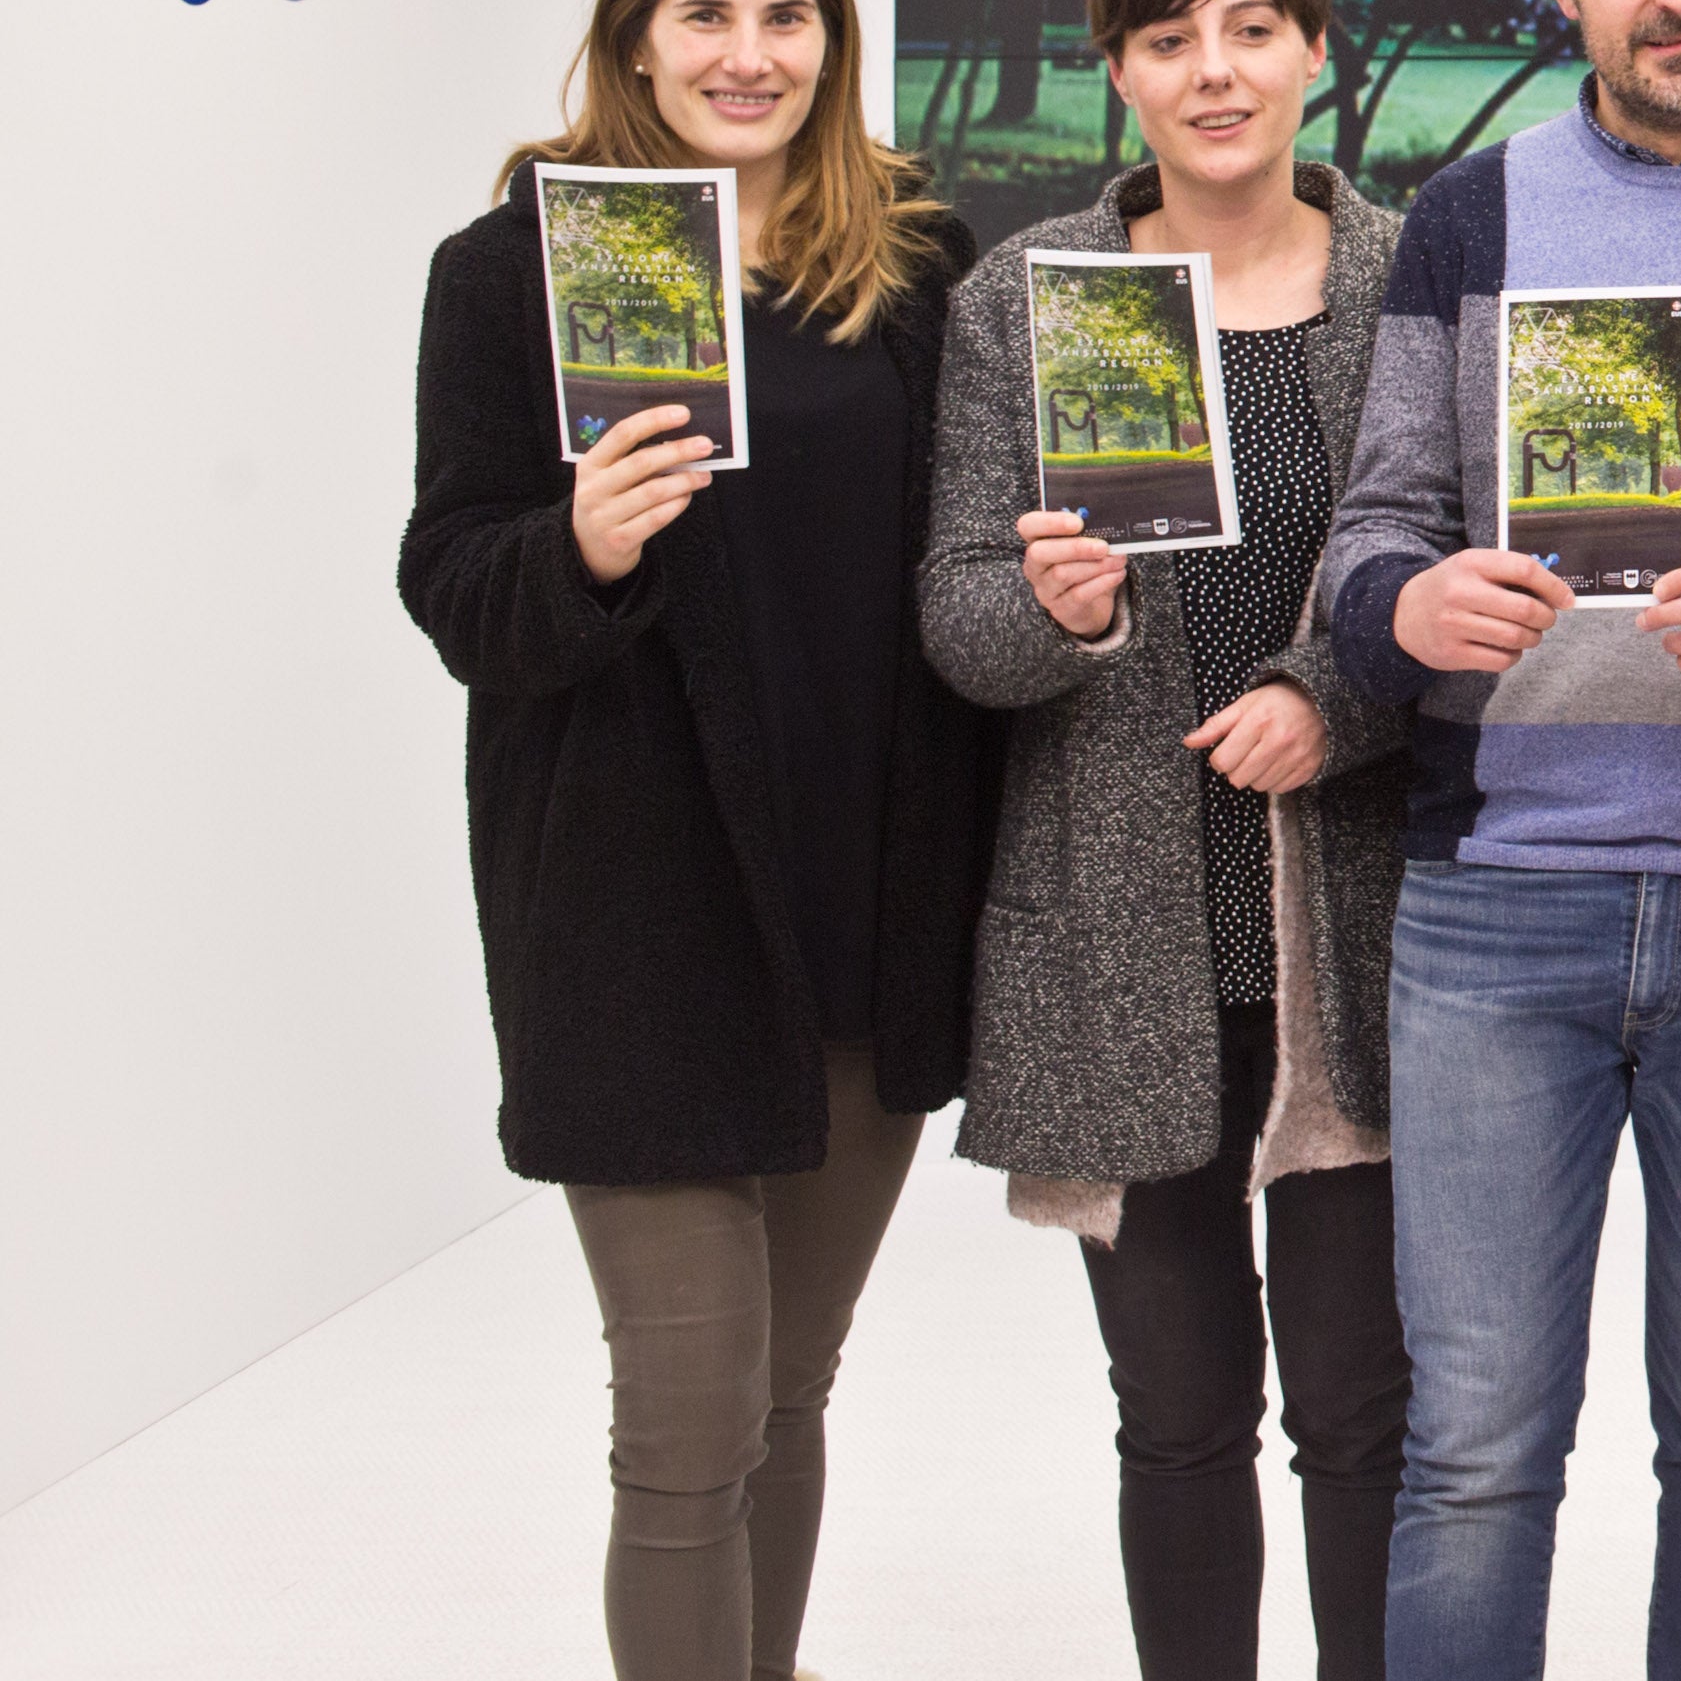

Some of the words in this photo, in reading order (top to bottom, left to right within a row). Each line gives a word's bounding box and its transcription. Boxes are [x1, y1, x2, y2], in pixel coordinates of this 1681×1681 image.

[597, 253, 671, 263] EXPLORE
[572, 263, 696, 273] SANSEBASTIAN
[619, 275, 684, 284] REGION
[1077, 337, 1149, 347] EXPLORE
[1100, 358, 1163, 367] REGION
[1561, 374, 1639, 383] EXPLORE
[1533, 383, 1663, 395] SANSEBASTIAN
[1585, 395, 1651, 405] REGION
